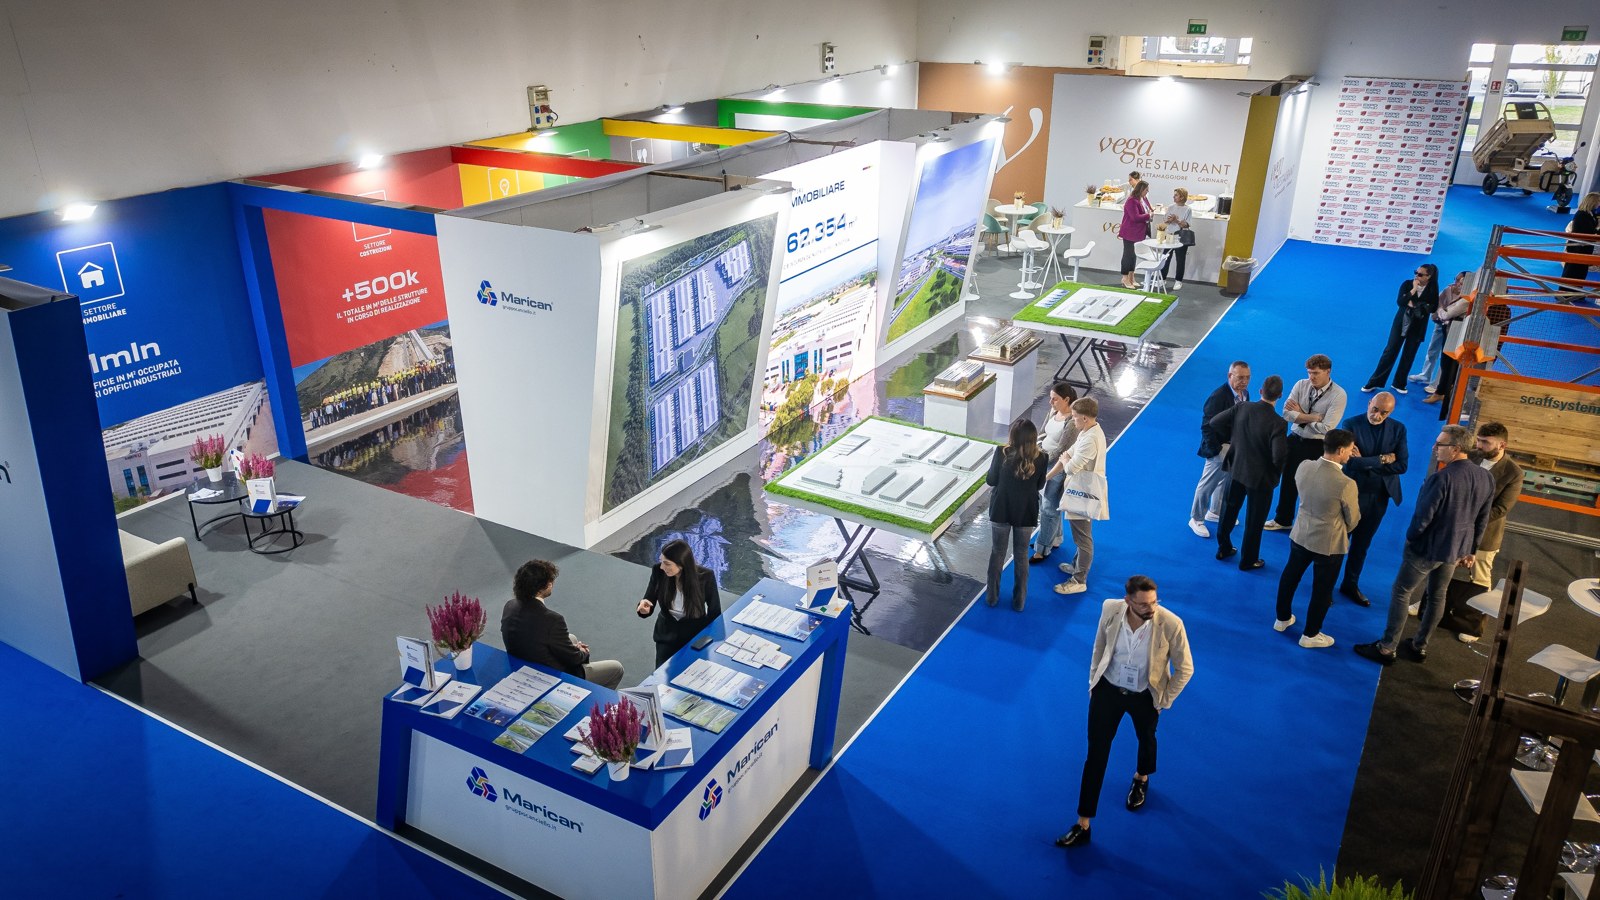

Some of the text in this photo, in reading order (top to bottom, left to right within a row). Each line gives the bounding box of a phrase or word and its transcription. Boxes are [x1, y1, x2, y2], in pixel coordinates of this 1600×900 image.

[1099, 136, 1155, 164] vega
[1136, 158, 1231, 176] RESTAURANT
[1140, 172, 1188, 181] ATTAMAGGIORE
[791, 180, 845, 208] MMOBILIARE
[359, 245, 393, 257] COSTRUZIONI
[363, 240, 386, 250] SETTORE
[342, 269, 420, 303] +500k
[83, 302, 117, 315] SETTORE
[336, 312, 343, 320] IL
[343, 306, 366, 317] TOTALE
[365, 303, 373, 311] IN
[379, 297, 398, 307] DELLE
[397, 287, 429, 302] STRUTTURE
[347, 297, 422, 324] IN CORSO DI REALIZZAZIONE
[501, 291, 553, 312] Marican
[93, 377, 116, 390] FICIE
[116, 373, 126, 383] IN
[137, 359, 179, 376] OCCUPATA
[102, 381, 133, 396] OPIFICI
[133, 366, 181, 386] INDUSTRIALI
[1520, 395, 1600, 415] scaffsystem
[727, 723, 778, 783] Marican
[503, 788, 582, 833] Marican
